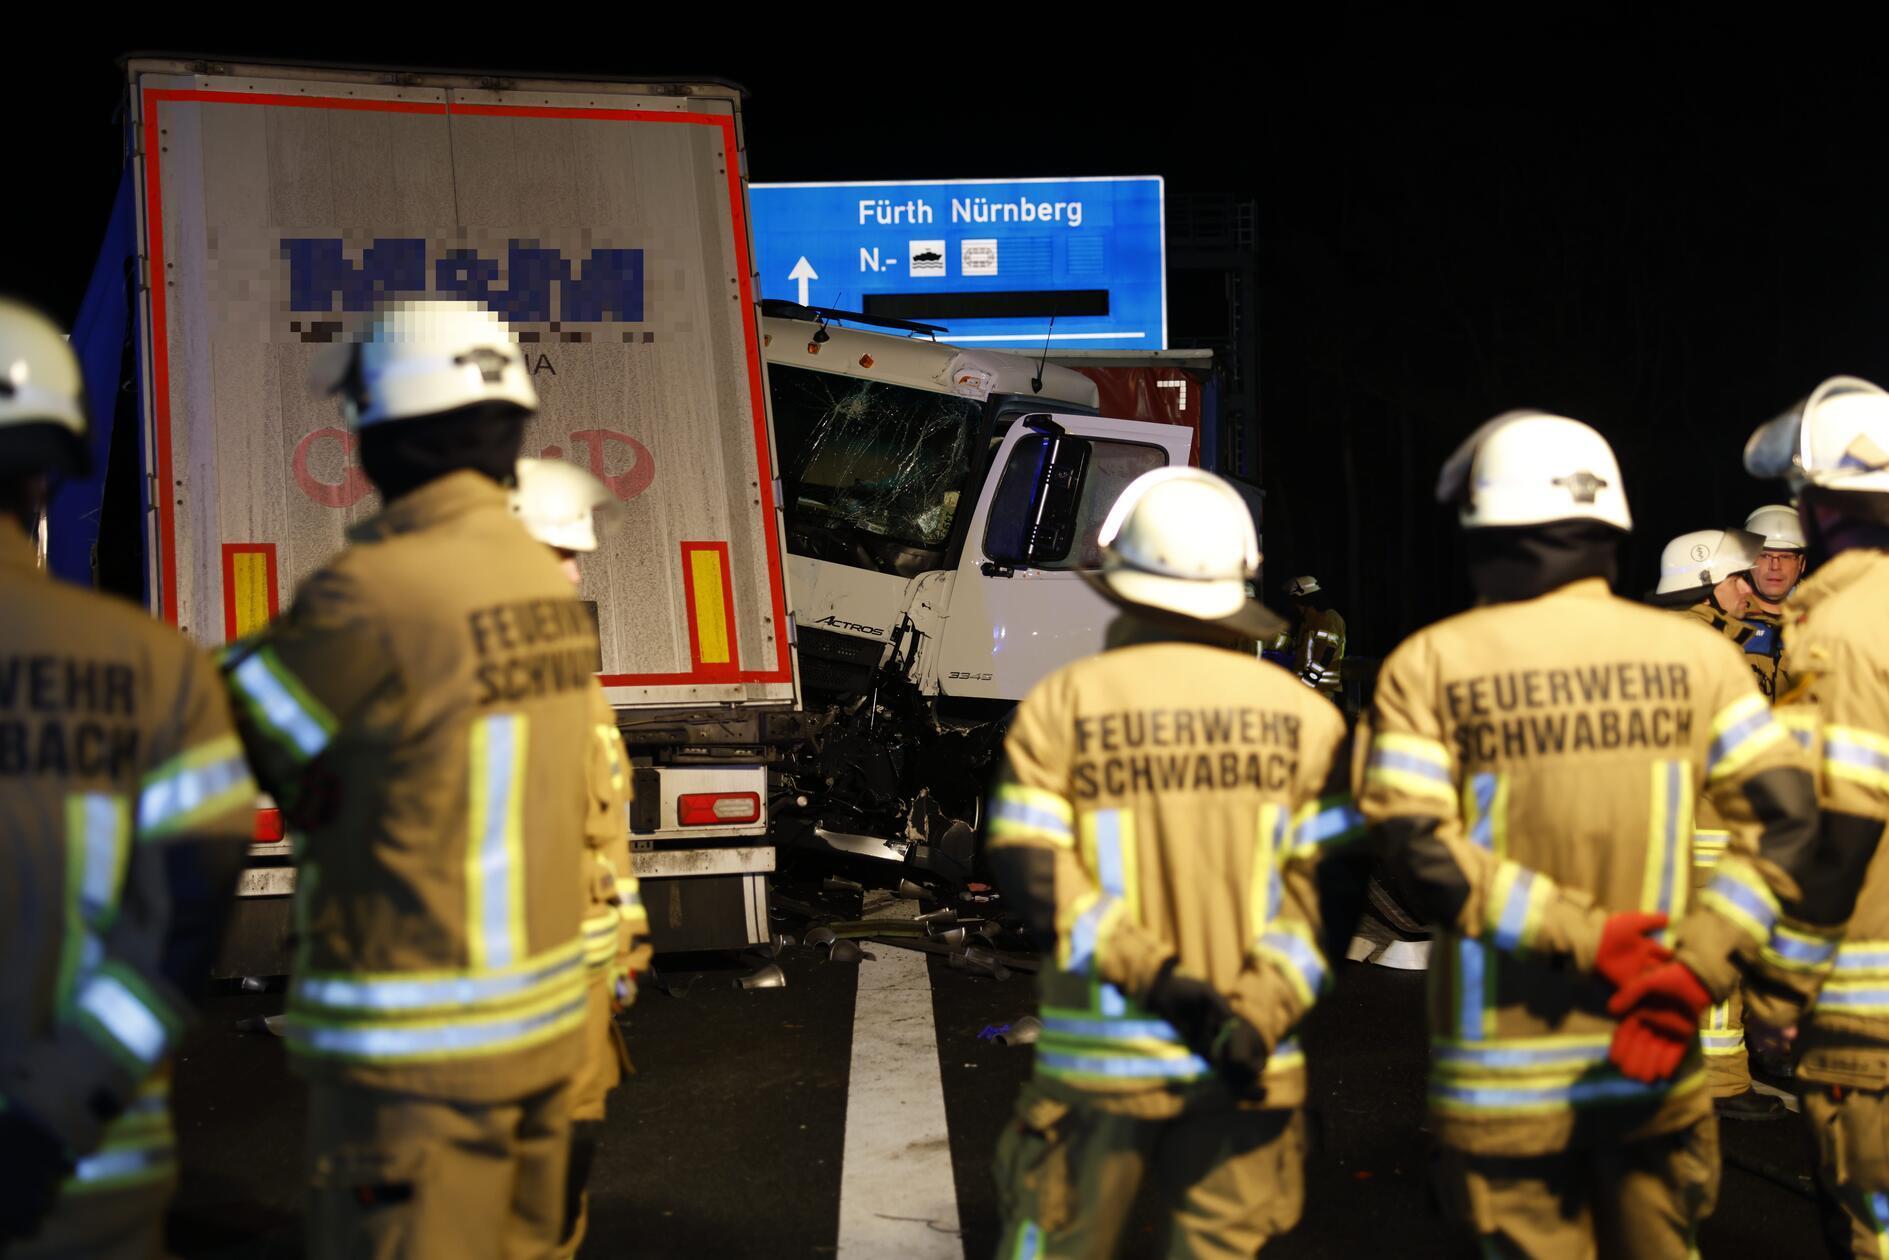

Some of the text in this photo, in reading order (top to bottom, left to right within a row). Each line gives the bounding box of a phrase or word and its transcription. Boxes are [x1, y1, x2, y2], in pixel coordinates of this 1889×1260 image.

[859, 197, 1083, 227] Fürth Nürnberg
[814, 615, 884, 636] ACTROS
[1446, 663, 1691, 719] FEUERWEHR
[1453, 708, 1694, 765] SCHWABACH
